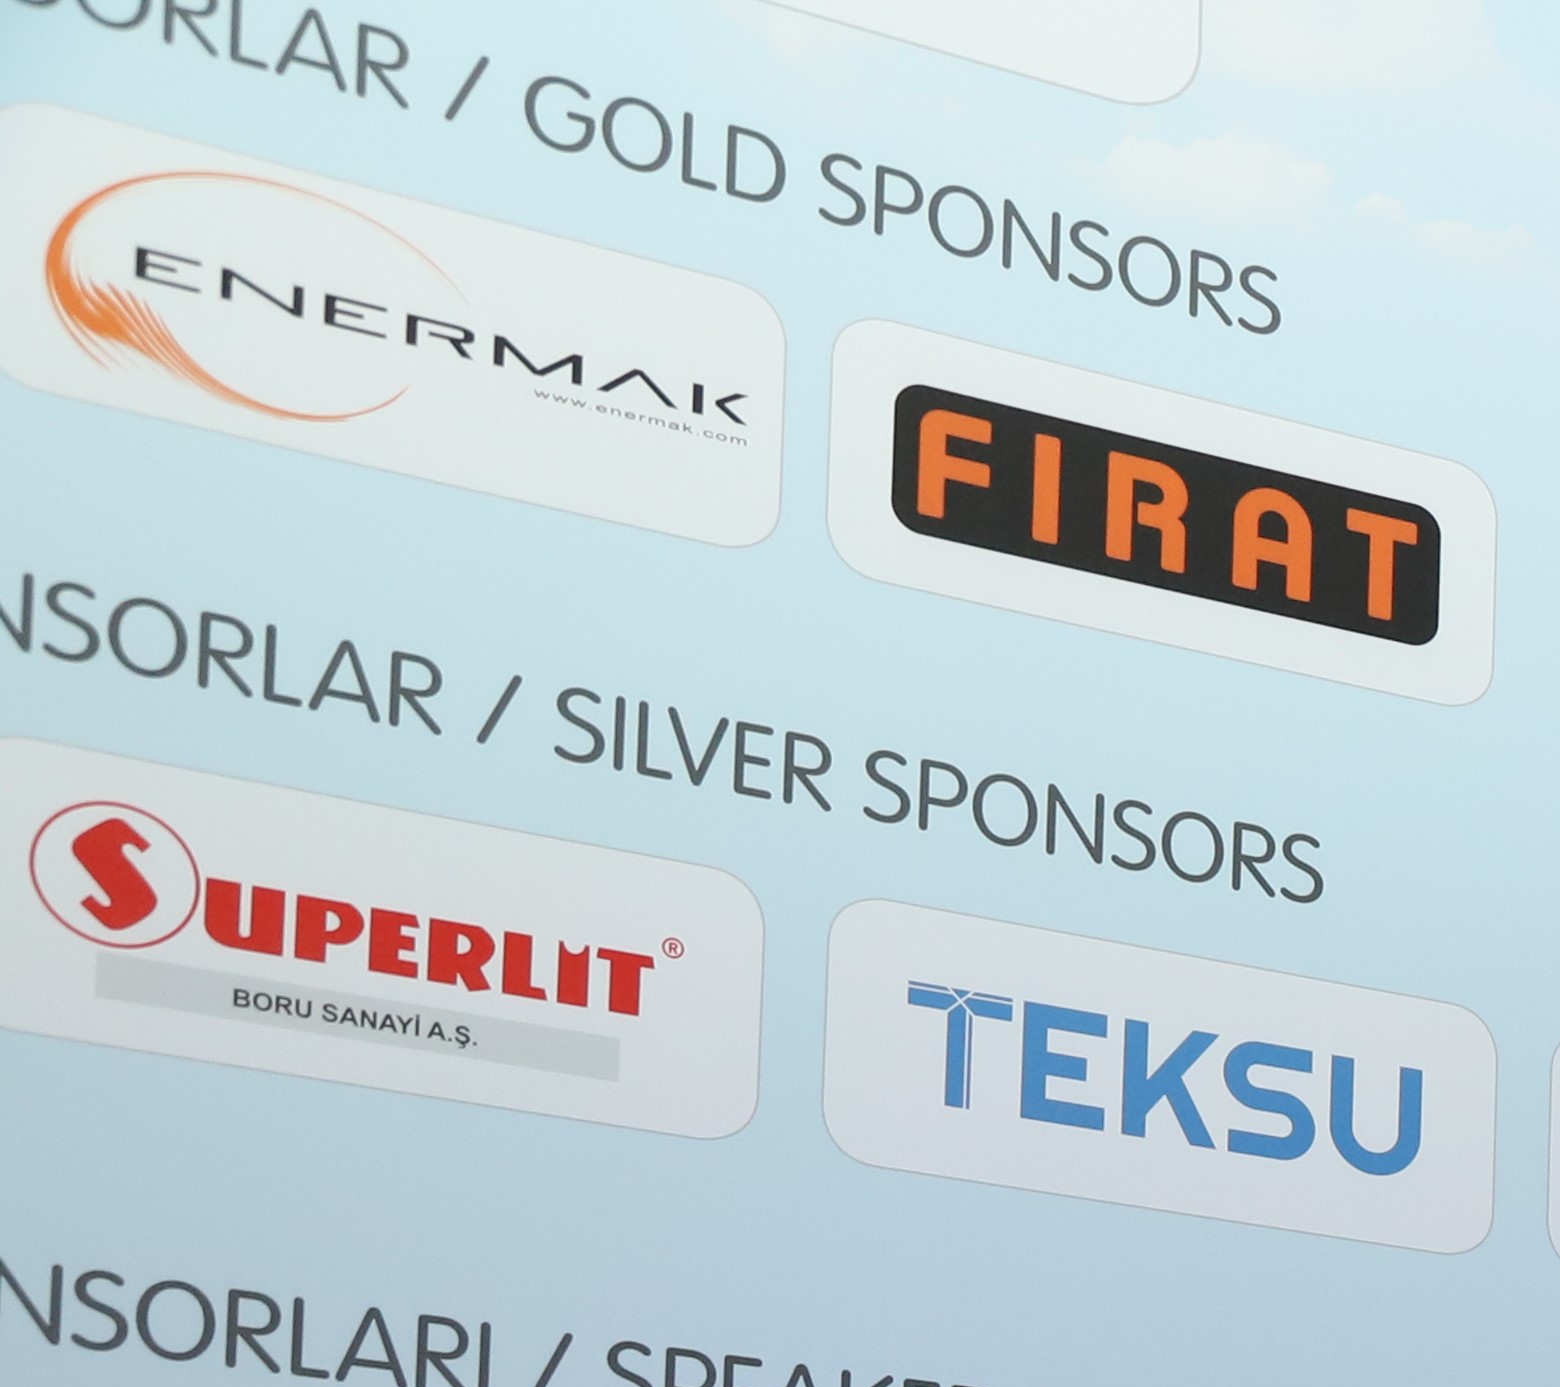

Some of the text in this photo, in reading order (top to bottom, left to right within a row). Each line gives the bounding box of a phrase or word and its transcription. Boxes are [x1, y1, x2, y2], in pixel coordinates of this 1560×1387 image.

[524, 75, 1283, 336] GOLD SPONSORS
[134, 246, 749, 426] ENERMAK
[533, 387, 749, 448] www.enermak.com
[916, 408, 1419, 621] FIRAT
[553, 686, 833, 812] SILVER
[862, 749, 1325, 904] SPONSORS
[233, 987, 479, 1049] BORU SANAYİ A.Ş.
[907, 979, 1423, 1176] TEKSU
